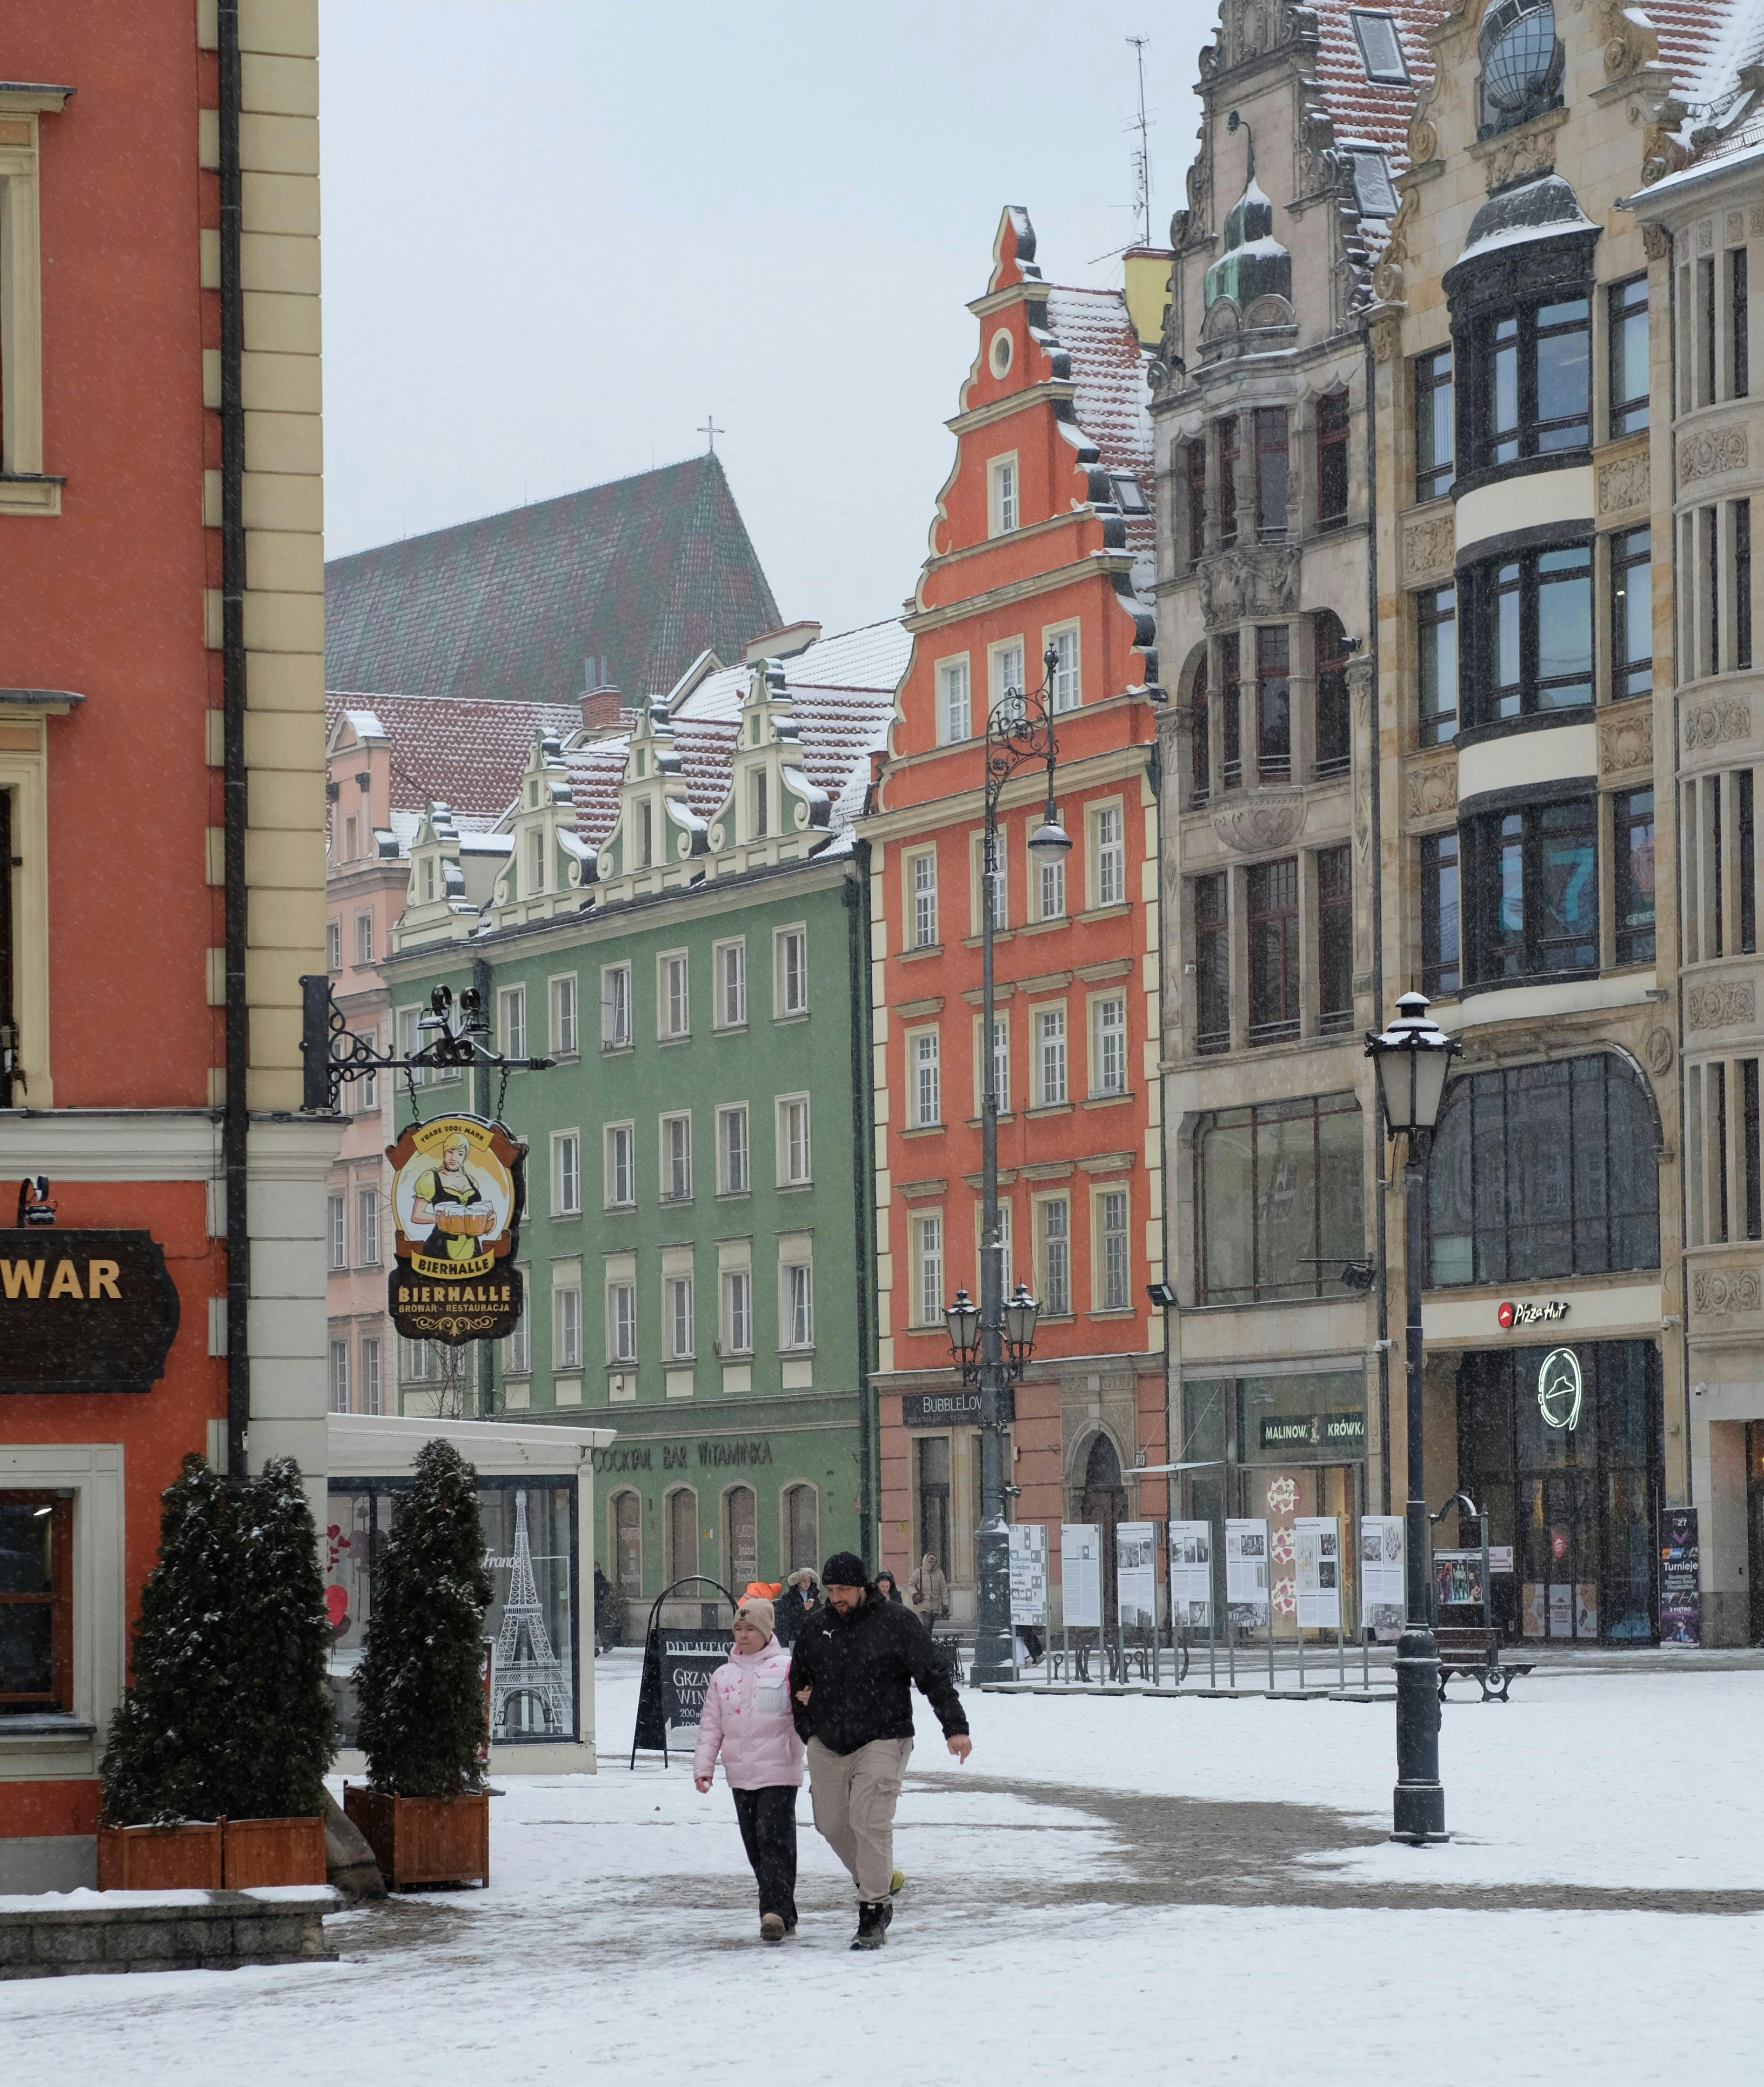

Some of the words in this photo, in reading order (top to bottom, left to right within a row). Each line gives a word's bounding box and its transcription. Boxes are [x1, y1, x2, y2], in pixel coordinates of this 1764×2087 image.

[420, 1127, 442, 1143] TRADE
[464, 1127, 485, 1141] MARK
[418, 1259, 489, 1275] BIERHALLE
[0, 1259, 122, 1299] WAR
[398, 1286, 510, 1302] BIERHALLE
[398, 1304, 437, 1313] BROWAR
[446, 1303, 510, 1312] RESTAURACJA
[1514, 1303, 1543, 1326] Pizza
[1544, 1301, 1567, 1321] Hut
[1266, 1424, 1308, 1440] MALINOW
[1663, 1561, 1698, 1572] Turnieje
